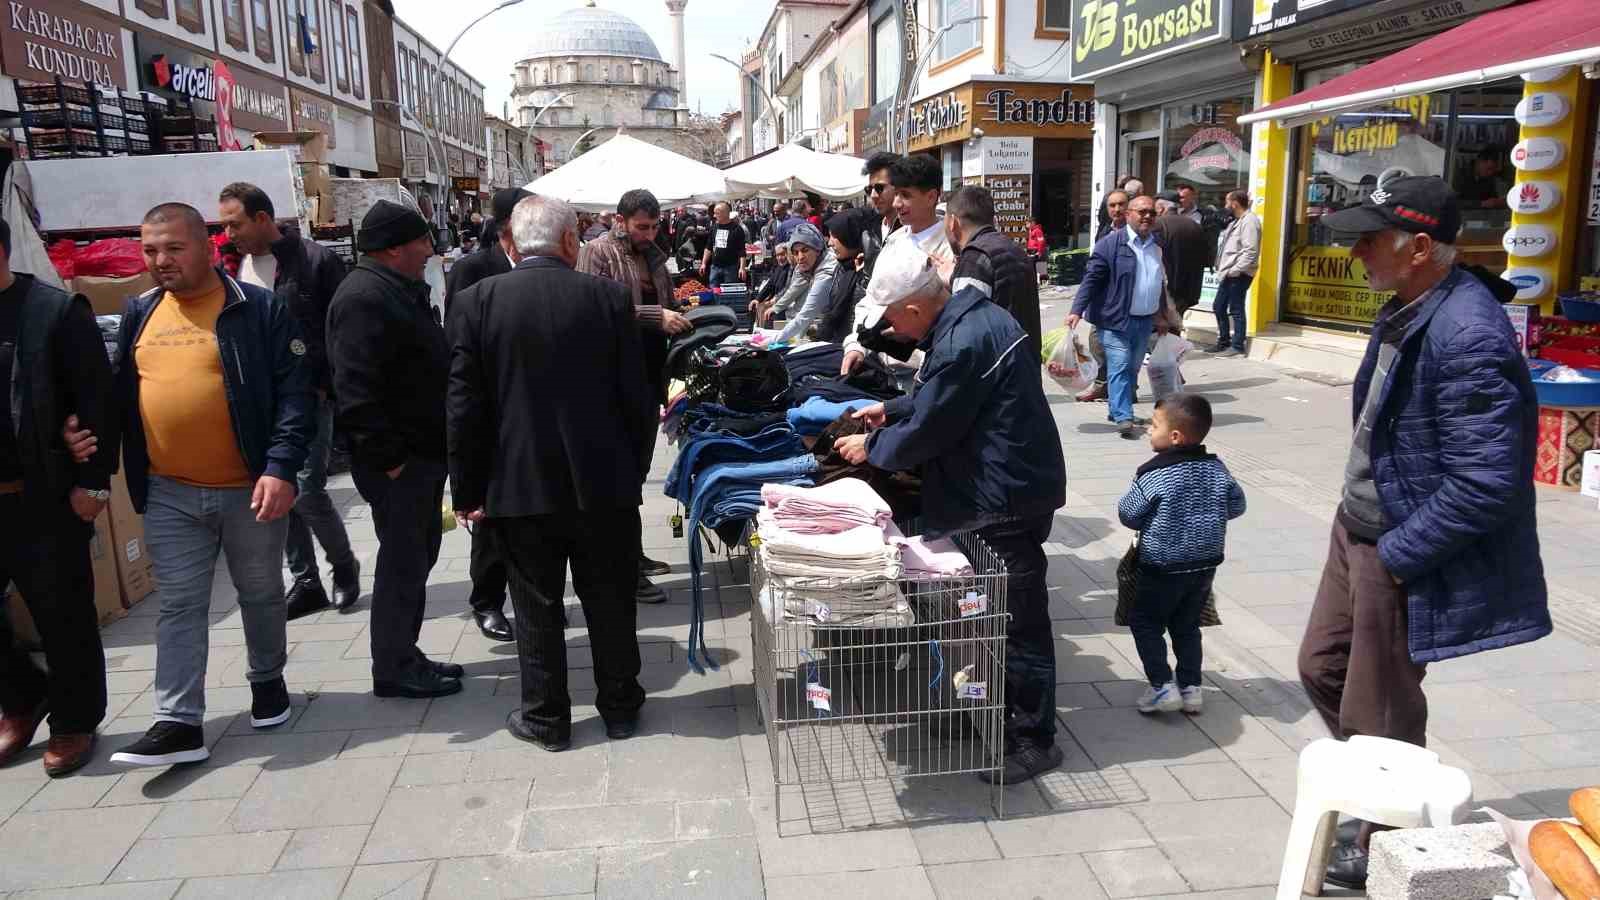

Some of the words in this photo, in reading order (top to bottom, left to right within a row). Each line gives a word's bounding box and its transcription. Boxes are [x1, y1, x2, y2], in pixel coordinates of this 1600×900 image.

[9, 1, 117, 58] KARABACAK
[1121, 0, 1213, 56] Borsası
[1274, 13, 1297, 29] PARLAK
[1328, 23, 1375, 45] TELEFONU
[25, 41, 112, 87] KUNDURA
[173, 63, 216, 103] arçeli
